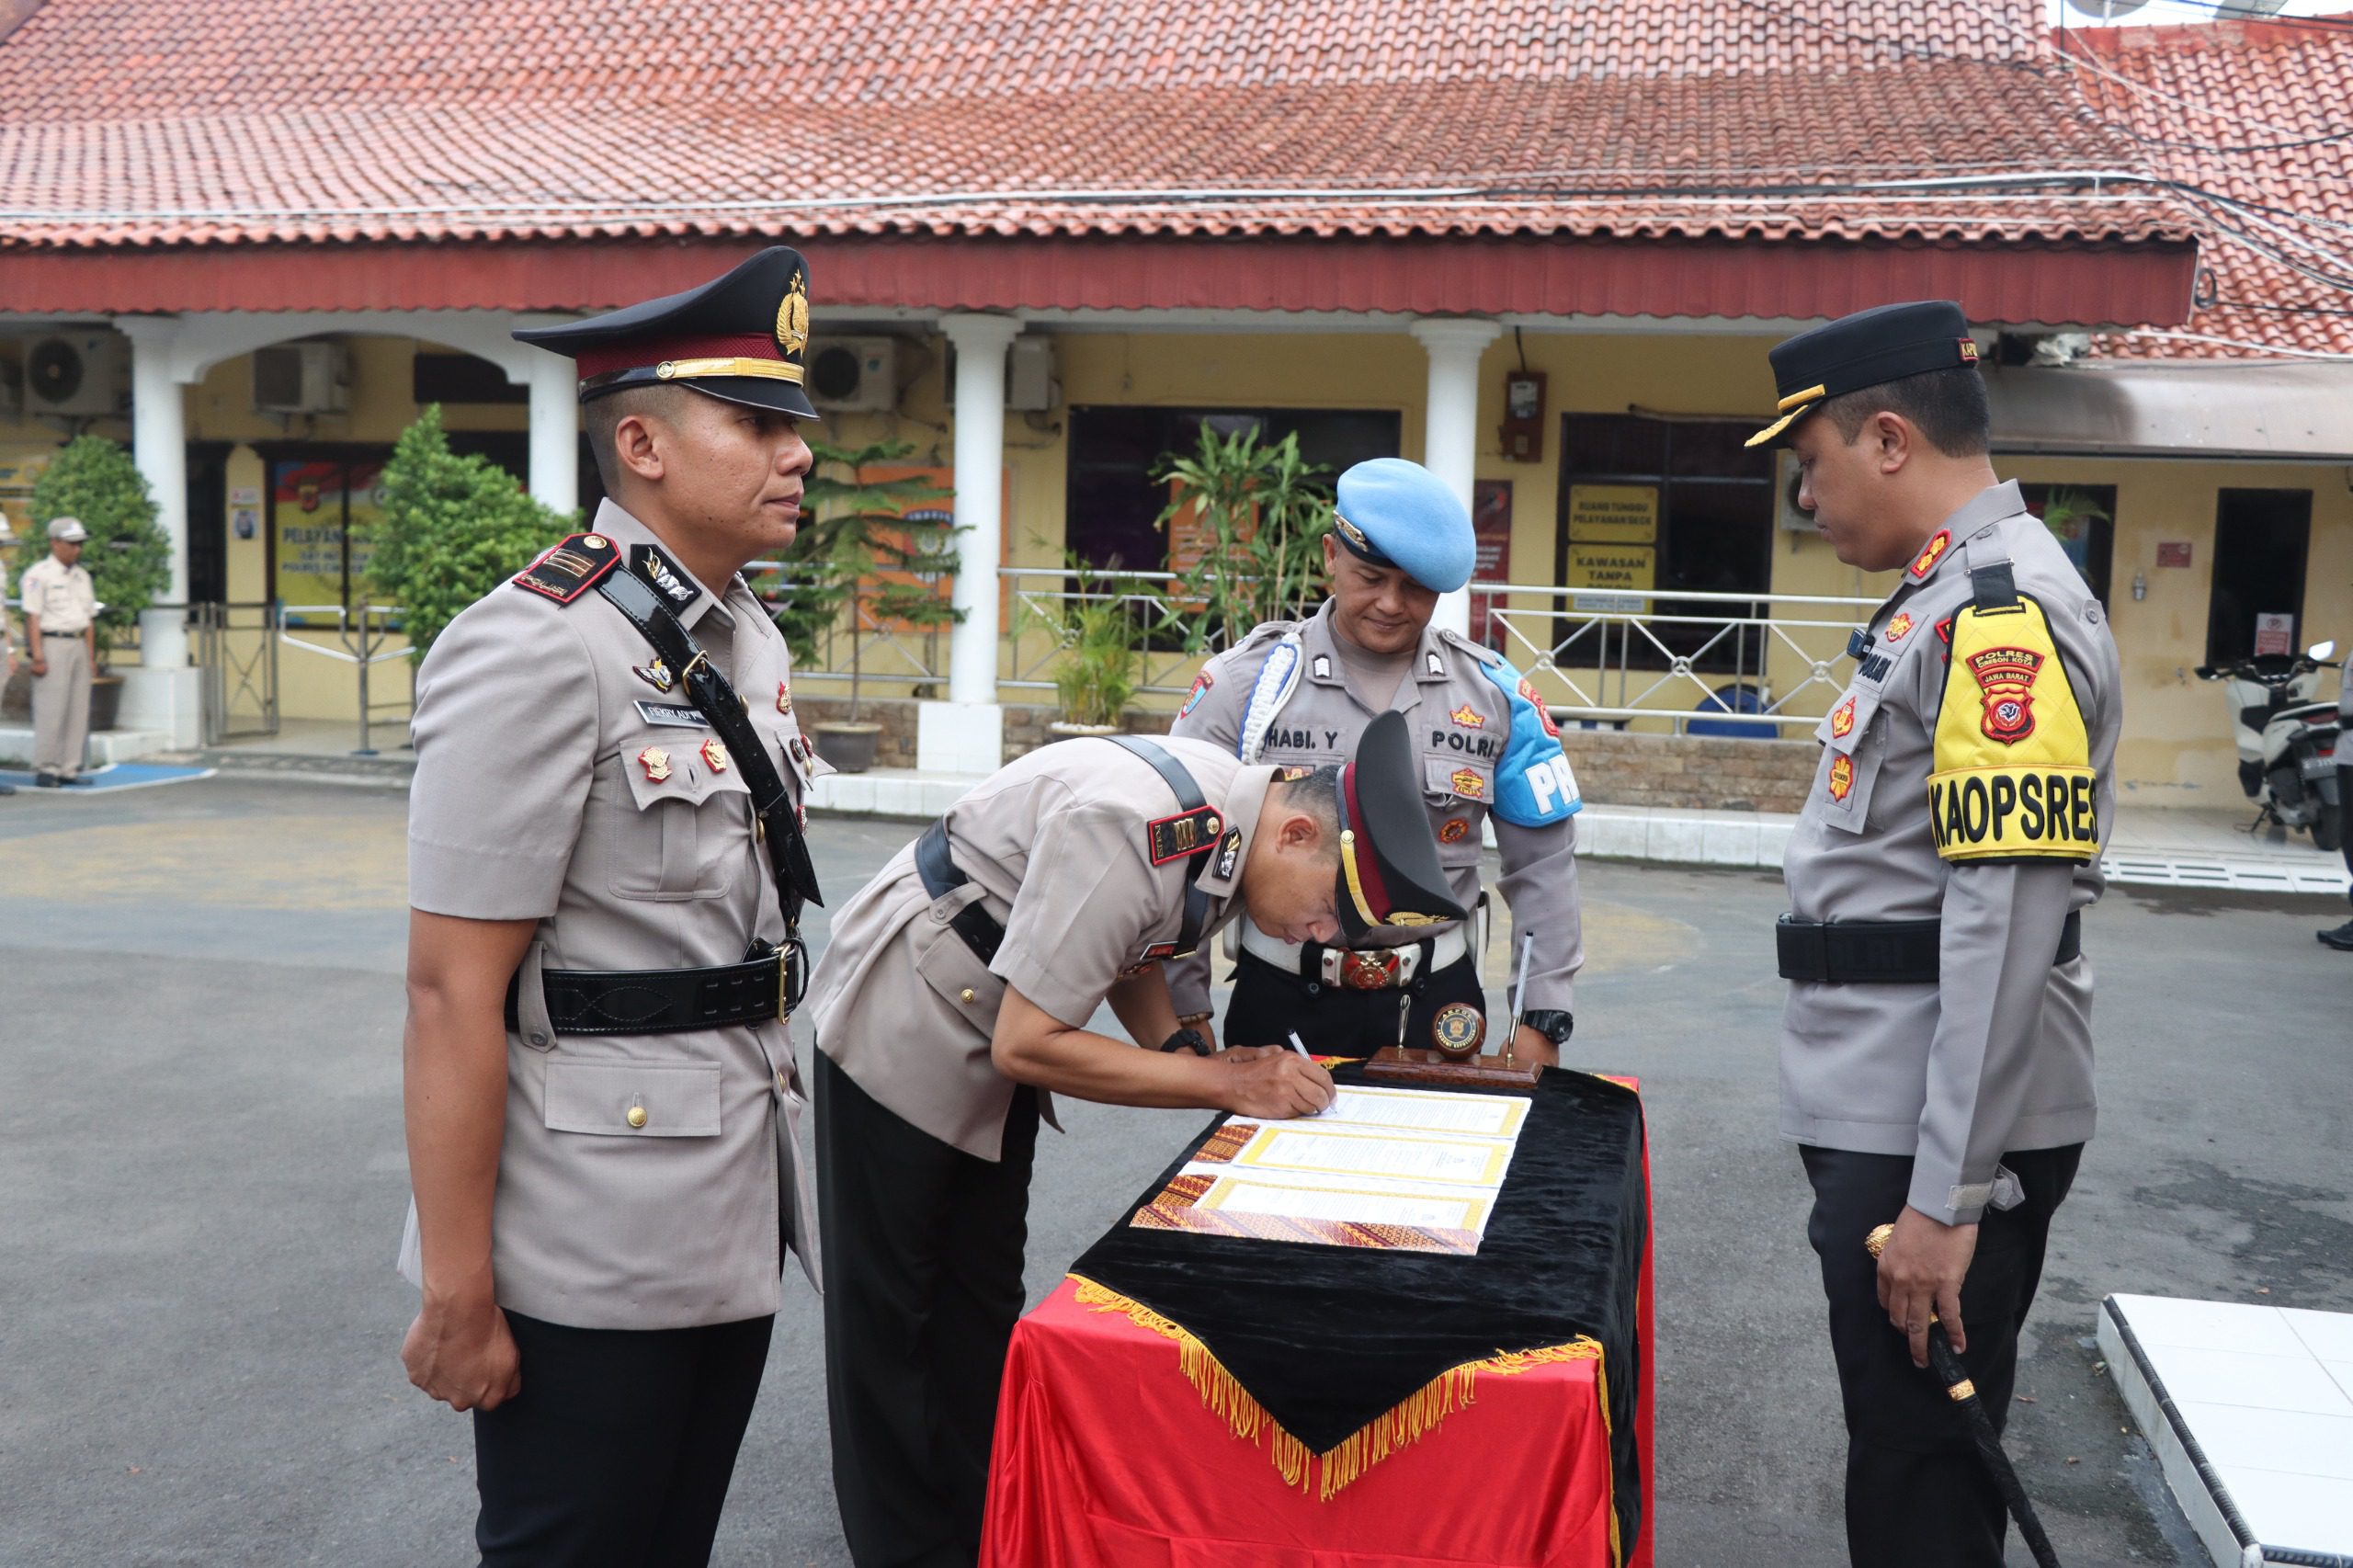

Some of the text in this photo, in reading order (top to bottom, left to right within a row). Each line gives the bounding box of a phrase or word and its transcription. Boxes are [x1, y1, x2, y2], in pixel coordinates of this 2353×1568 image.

[1576, 557, 1645, 568] KAWASAN
[1587, 571, 1632, 581] TANPA
[1974, 650, 2034, 664] POLRES
[1977, 657, 2033, 668] CIREBON KOTA
[1984, 672, 2029, 683] JAWA BARAT
[1324, 731, 1338, 749] Y
[1431, 731, 1495, 758] POLRI
[1930, 773, 2099, 848] KAOPSRES
